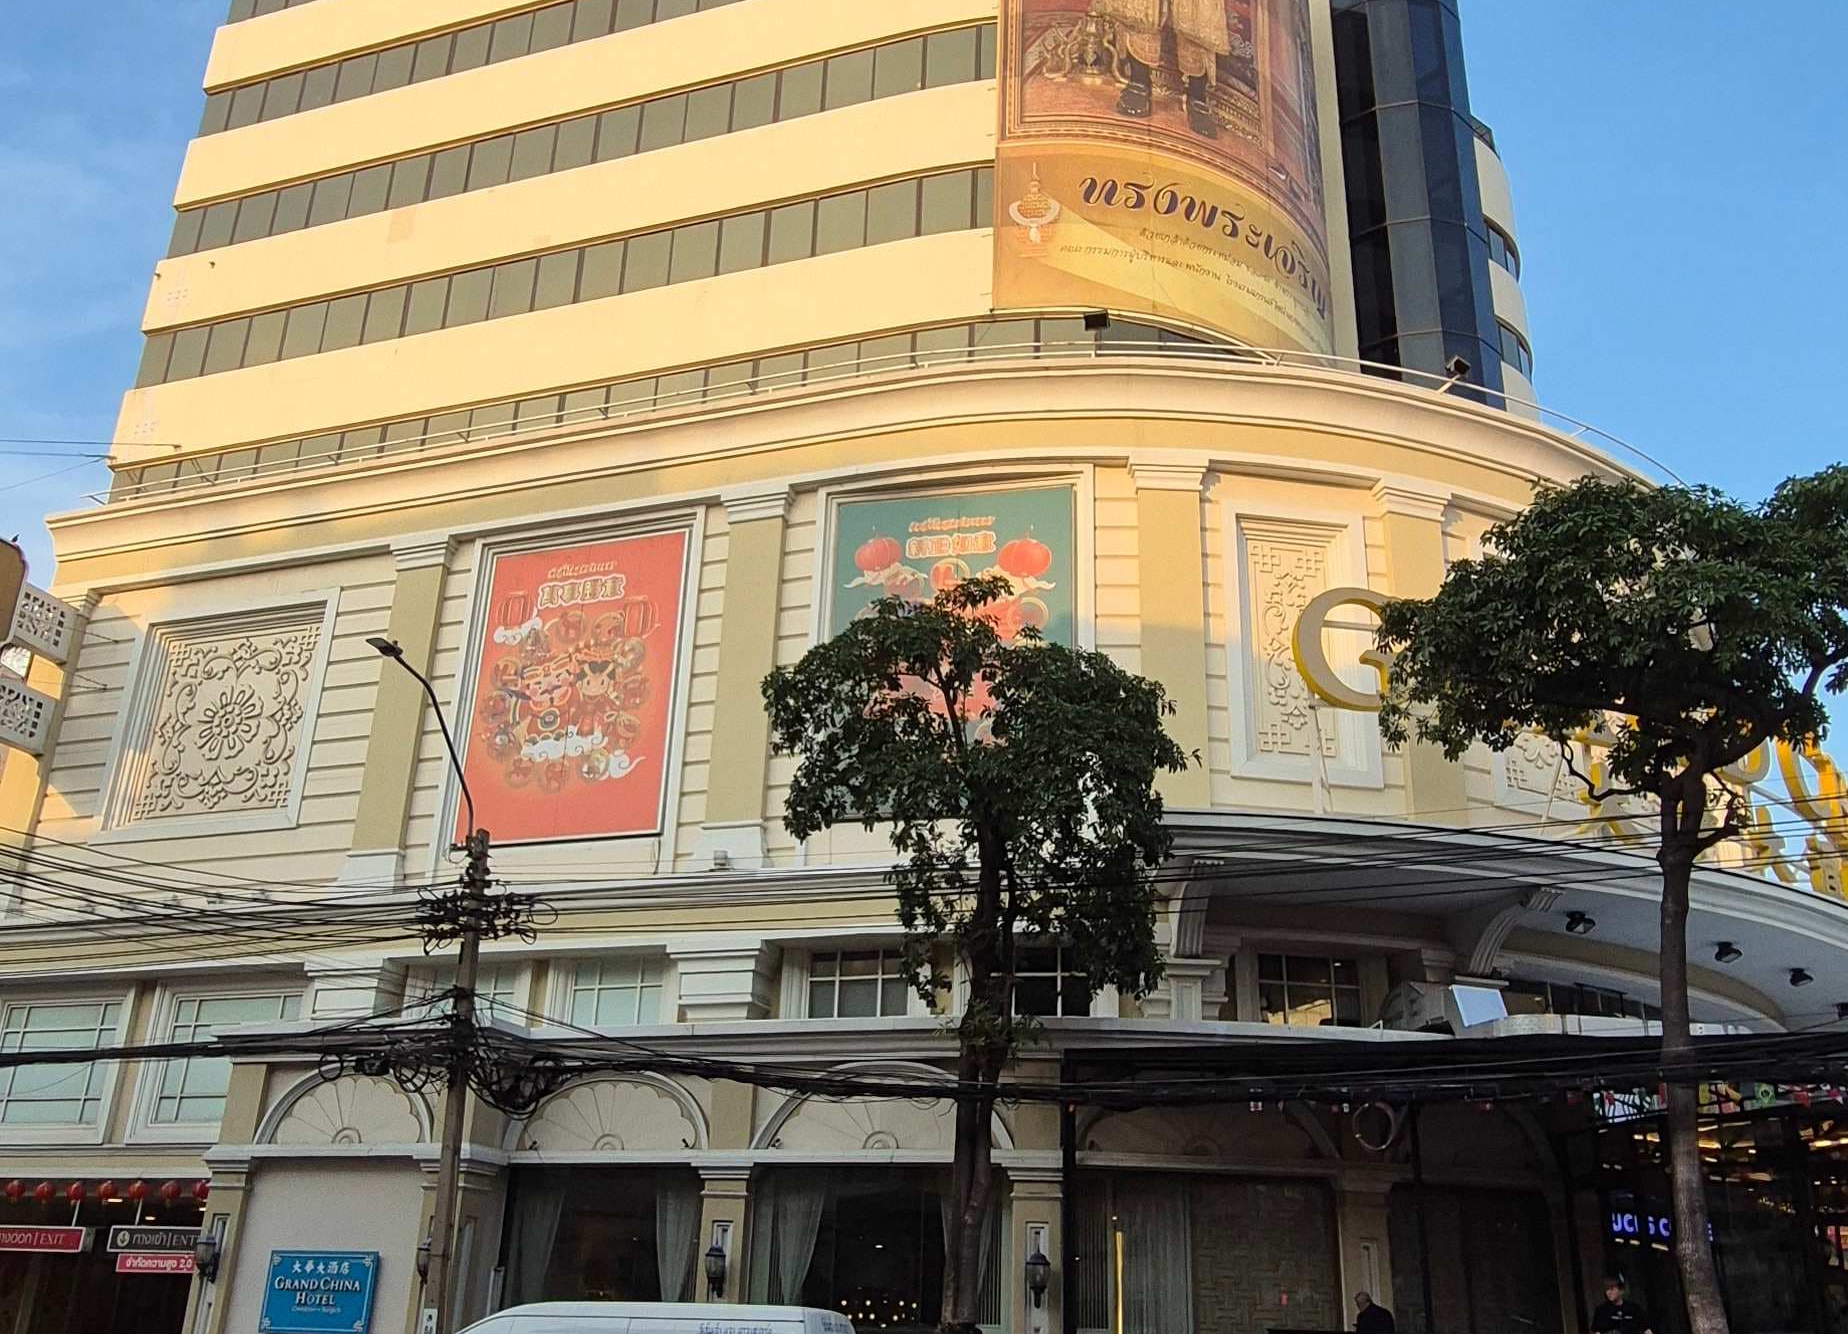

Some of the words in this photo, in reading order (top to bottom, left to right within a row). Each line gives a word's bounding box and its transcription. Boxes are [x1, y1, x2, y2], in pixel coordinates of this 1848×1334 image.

[1079, 175, 1327, 321] ทรงพระเจริญ
[40, 1233, 66, 1245] EXIT
[292, 1259, 350, 1275] 大華大酒店
[274, 1275, 318, 1291] GRAND
[320, 1277, 361, 1292] CHINA
[295, 1291, 336, 1306] HOTEL
